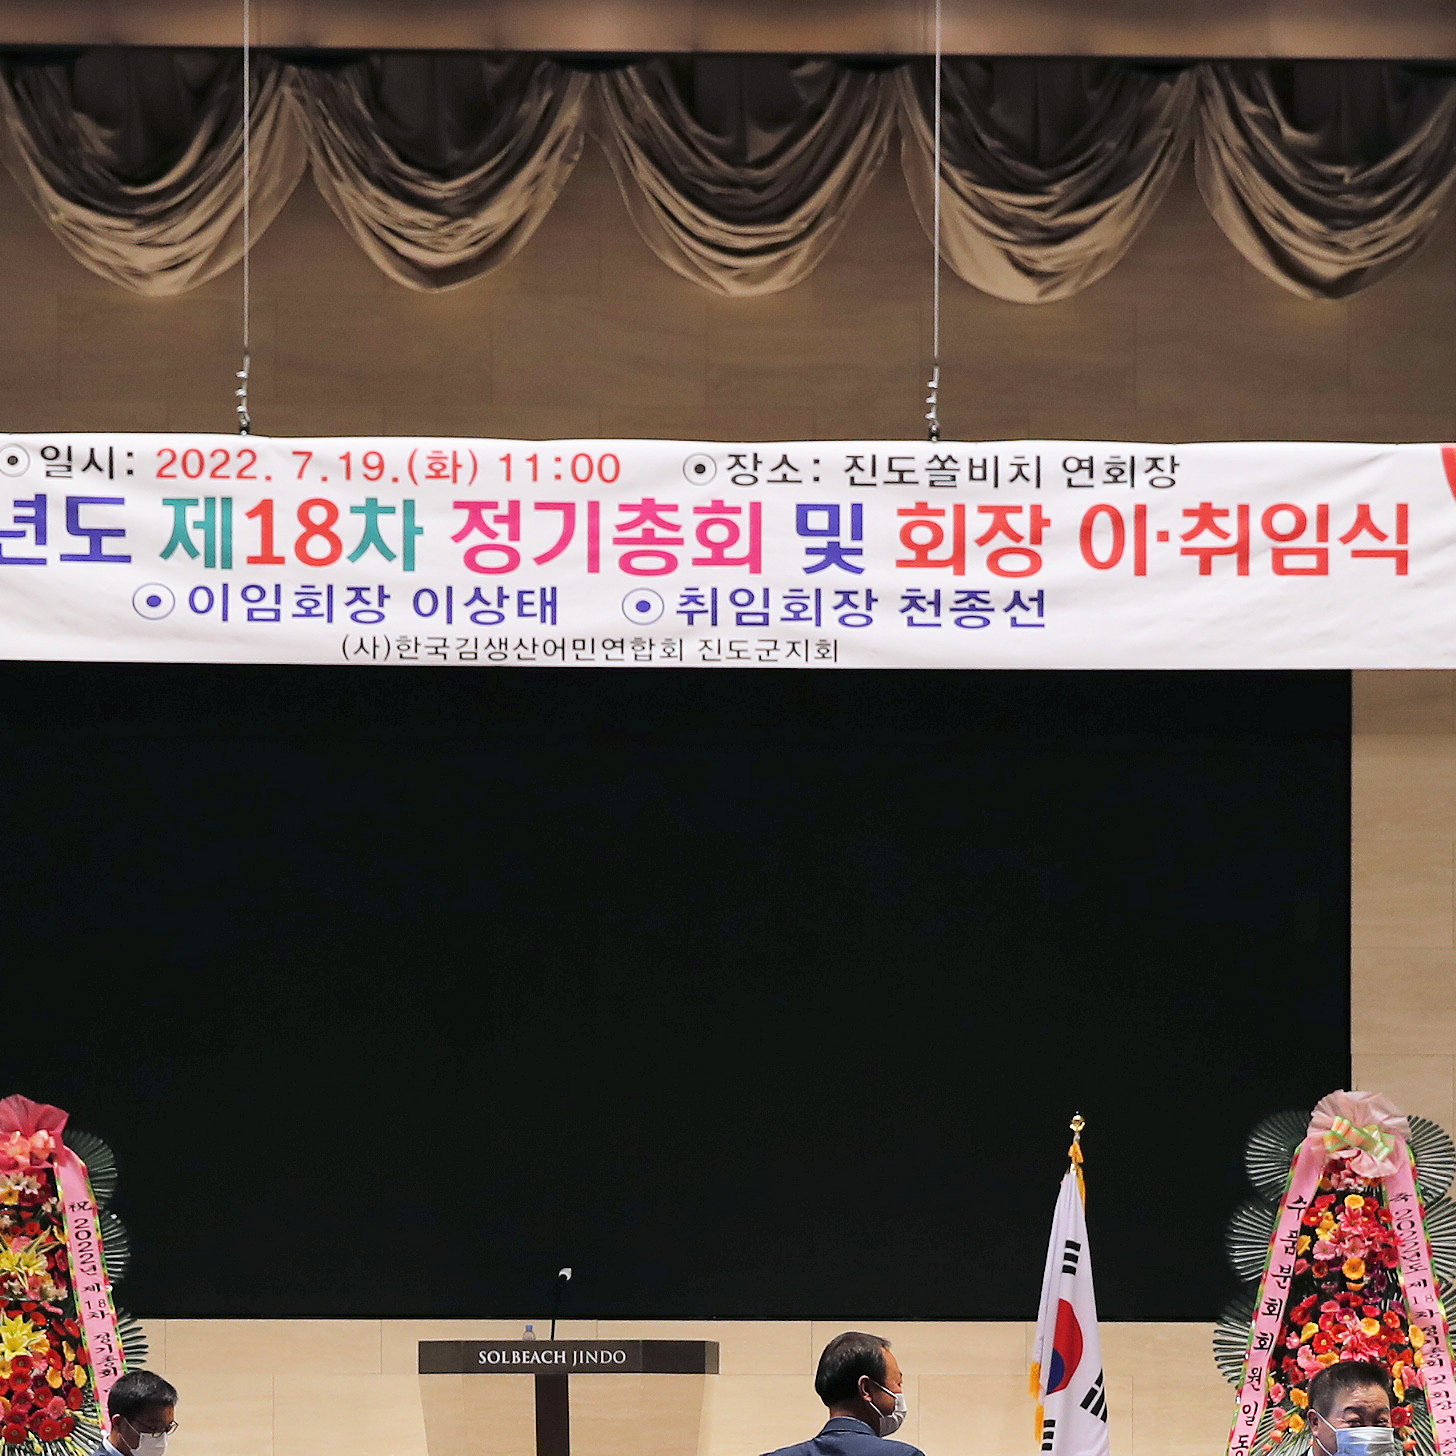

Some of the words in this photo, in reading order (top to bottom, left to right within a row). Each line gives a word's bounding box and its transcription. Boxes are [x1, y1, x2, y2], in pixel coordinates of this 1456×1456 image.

[155, 448, 273, 482] 2022.
[498, 452, 621, 485] 11:00
[843, 453, 1043, 490] 진도쏠비치
[1061, 454, 1181, 490] 연회장
[159, 496, 424, 572] 제18차
[450, 497, 763, 576] 정기총회
[794, 502, 866, 576] 및
[895, 500, 1052, 578] 회장
[188, 582, 392, 625] 이임회장
[412, 585, 558, 626] 이상태
[675, 586, 879, 629] 취임회장
[898, 587, 1046, 630] 천종선
[341, 634, 684, 662] (사)한국김생산어민연합회
[698, 638, 838, 664] 진도군지회
[477, 1350, 567, 1365] SOLBEACH
[571, 1350, 627, 1367] JINDO
